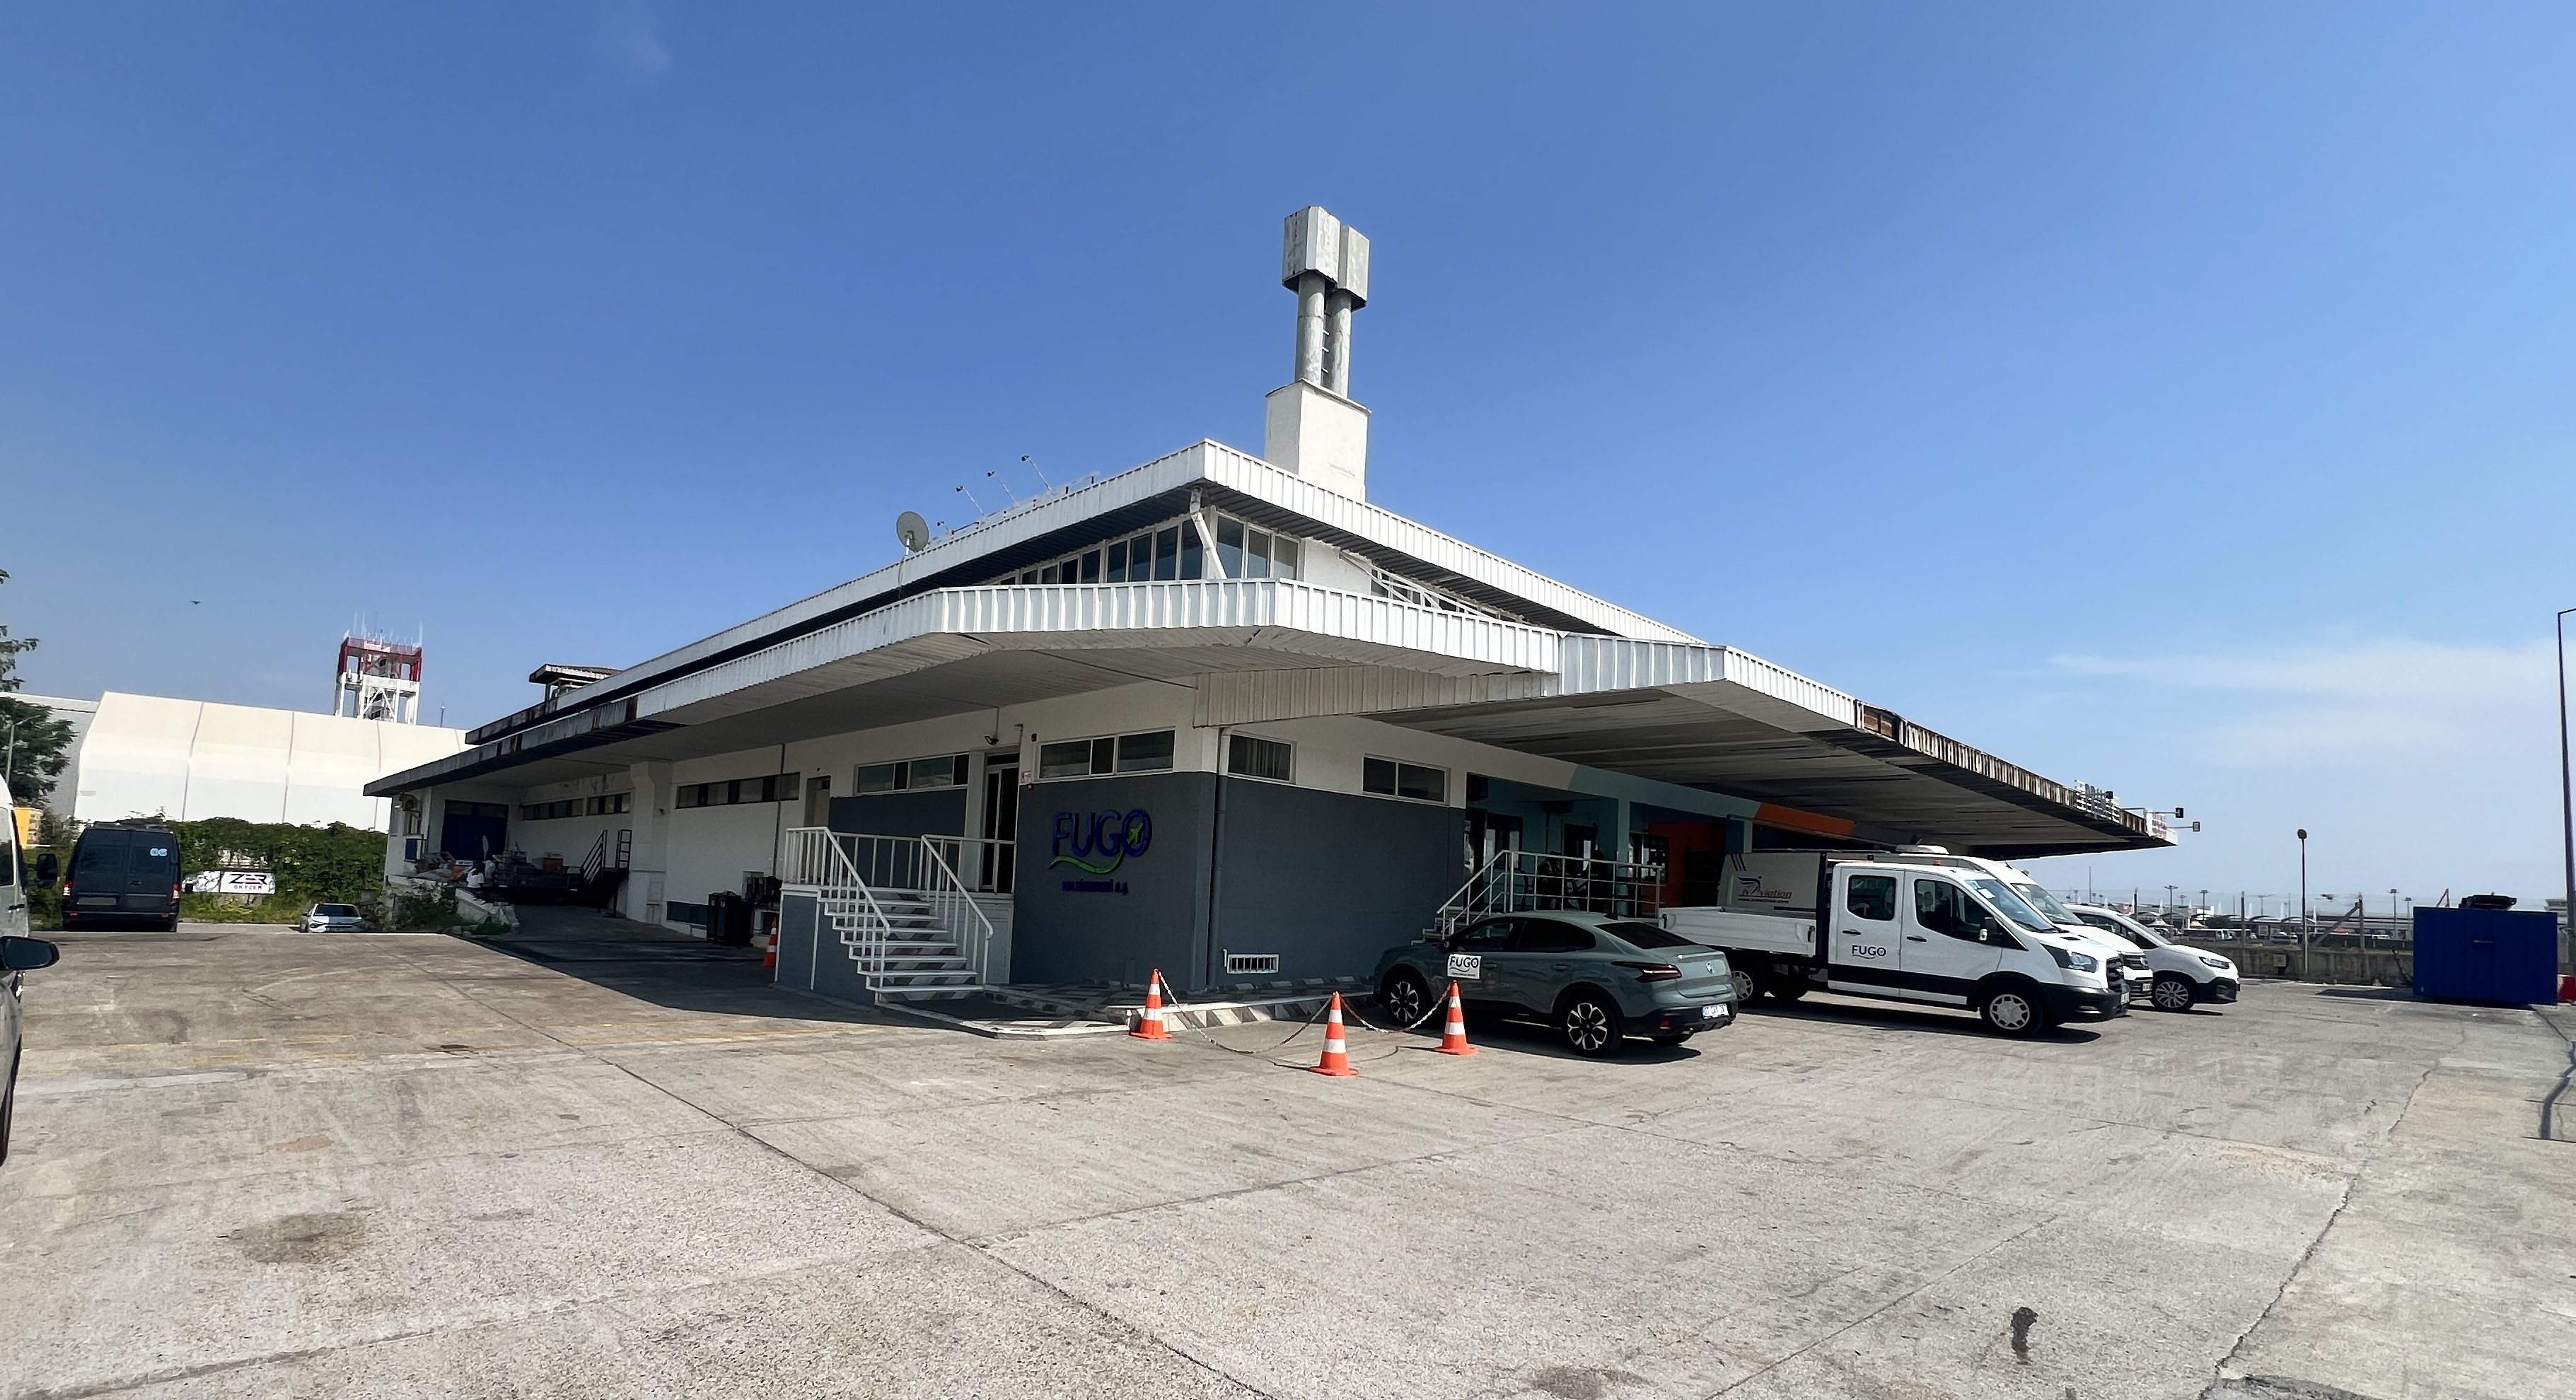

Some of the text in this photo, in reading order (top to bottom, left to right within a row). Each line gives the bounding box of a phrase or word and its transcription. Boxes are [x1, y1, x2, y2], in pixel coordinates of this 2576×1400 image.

[1052, 810, 1152, 857] FUGO
[1852, 945, 1886, 956] FUGO
[1449, 956, 1479, 968] FUGO
